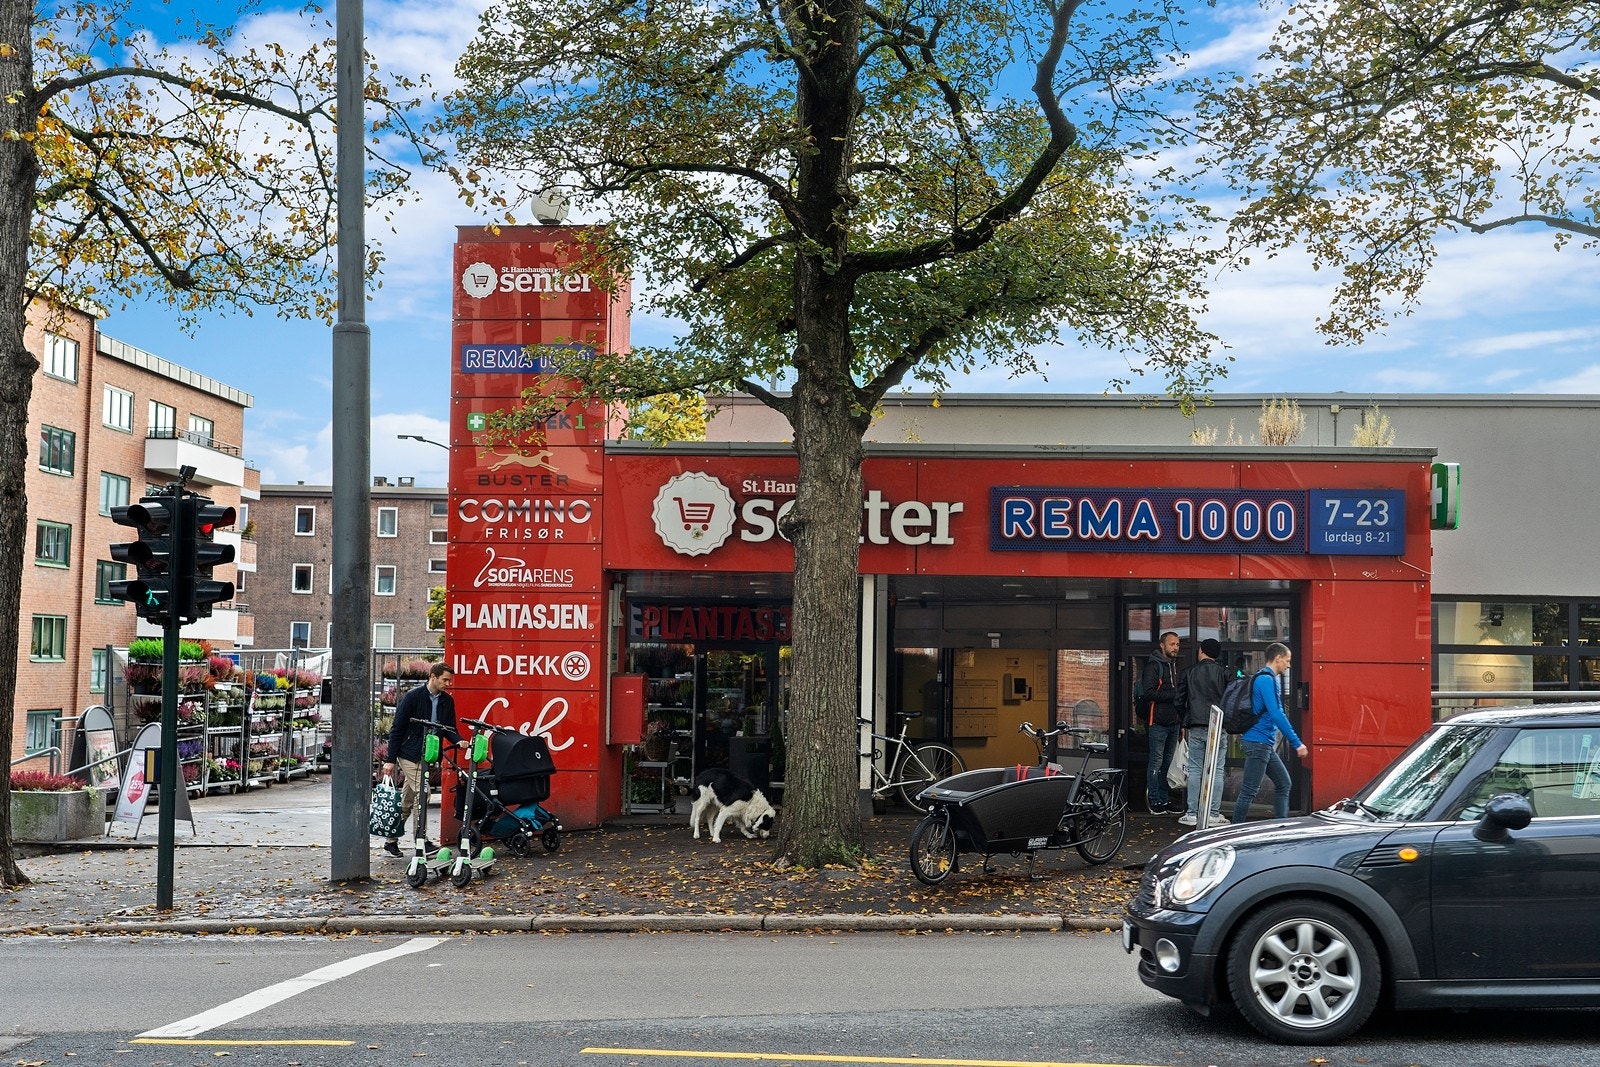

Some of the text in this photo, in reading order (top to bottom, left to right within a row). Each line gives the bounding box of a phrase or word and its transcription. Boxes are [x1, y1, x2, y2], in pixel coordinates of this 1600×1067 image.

[511, 266, 554, 274] Hanshaugen
[500, 268, 594, 293] senter
[465, 349, 534, 369] REMA
[575, 413, 586, 430] 1
[478, 474, 569, 486] BUSTER
[742, 480, 798, 493] St. Han
[458, 498, 592, 524] COMINO
[740, 489, 964, 545] ster
[1002, 498, 1296, 541] REMA 1000
[1325, 499, 1389, 526] 7-23
[485, 528, 564, 539] FRISØR
[1325, 531, 1390, 545] lørdag 8-21
[487, 568, 574, 583] SOFIARENS
[642, 604, 793, 641] PLANTASJ
[453, 654, 561, 676] ILA DEKK
